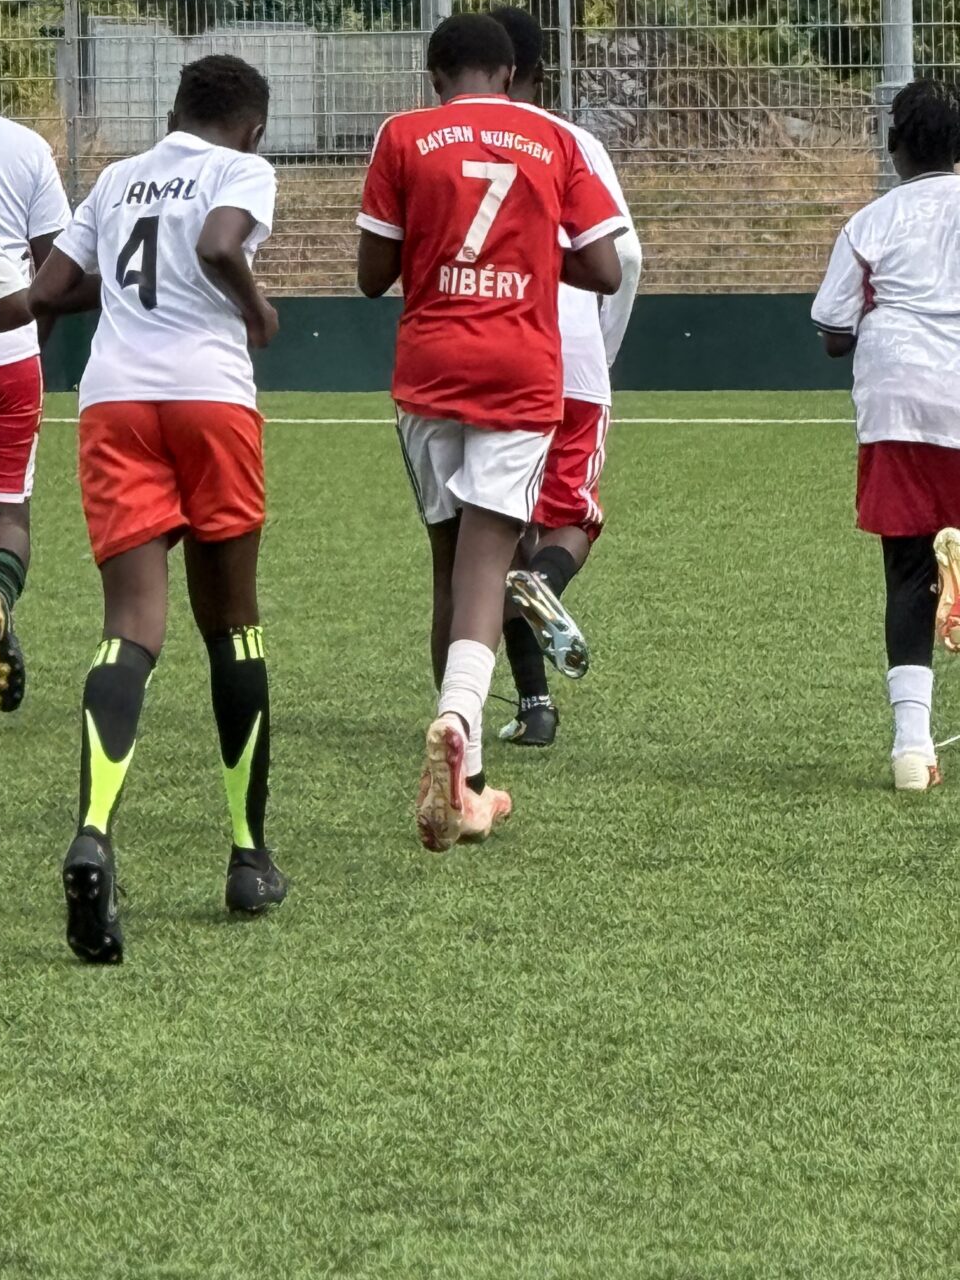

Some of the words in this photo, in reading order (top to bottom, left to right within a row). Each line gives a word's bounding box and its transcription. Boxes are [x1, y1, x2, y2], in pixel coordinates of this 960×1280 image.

[415, 125, 475, 156] BAYERN
[455, 160, 518, 263] 7
[115, 215, 160, 311] 4
[438, 263, 533, 300] RIBÉRY
